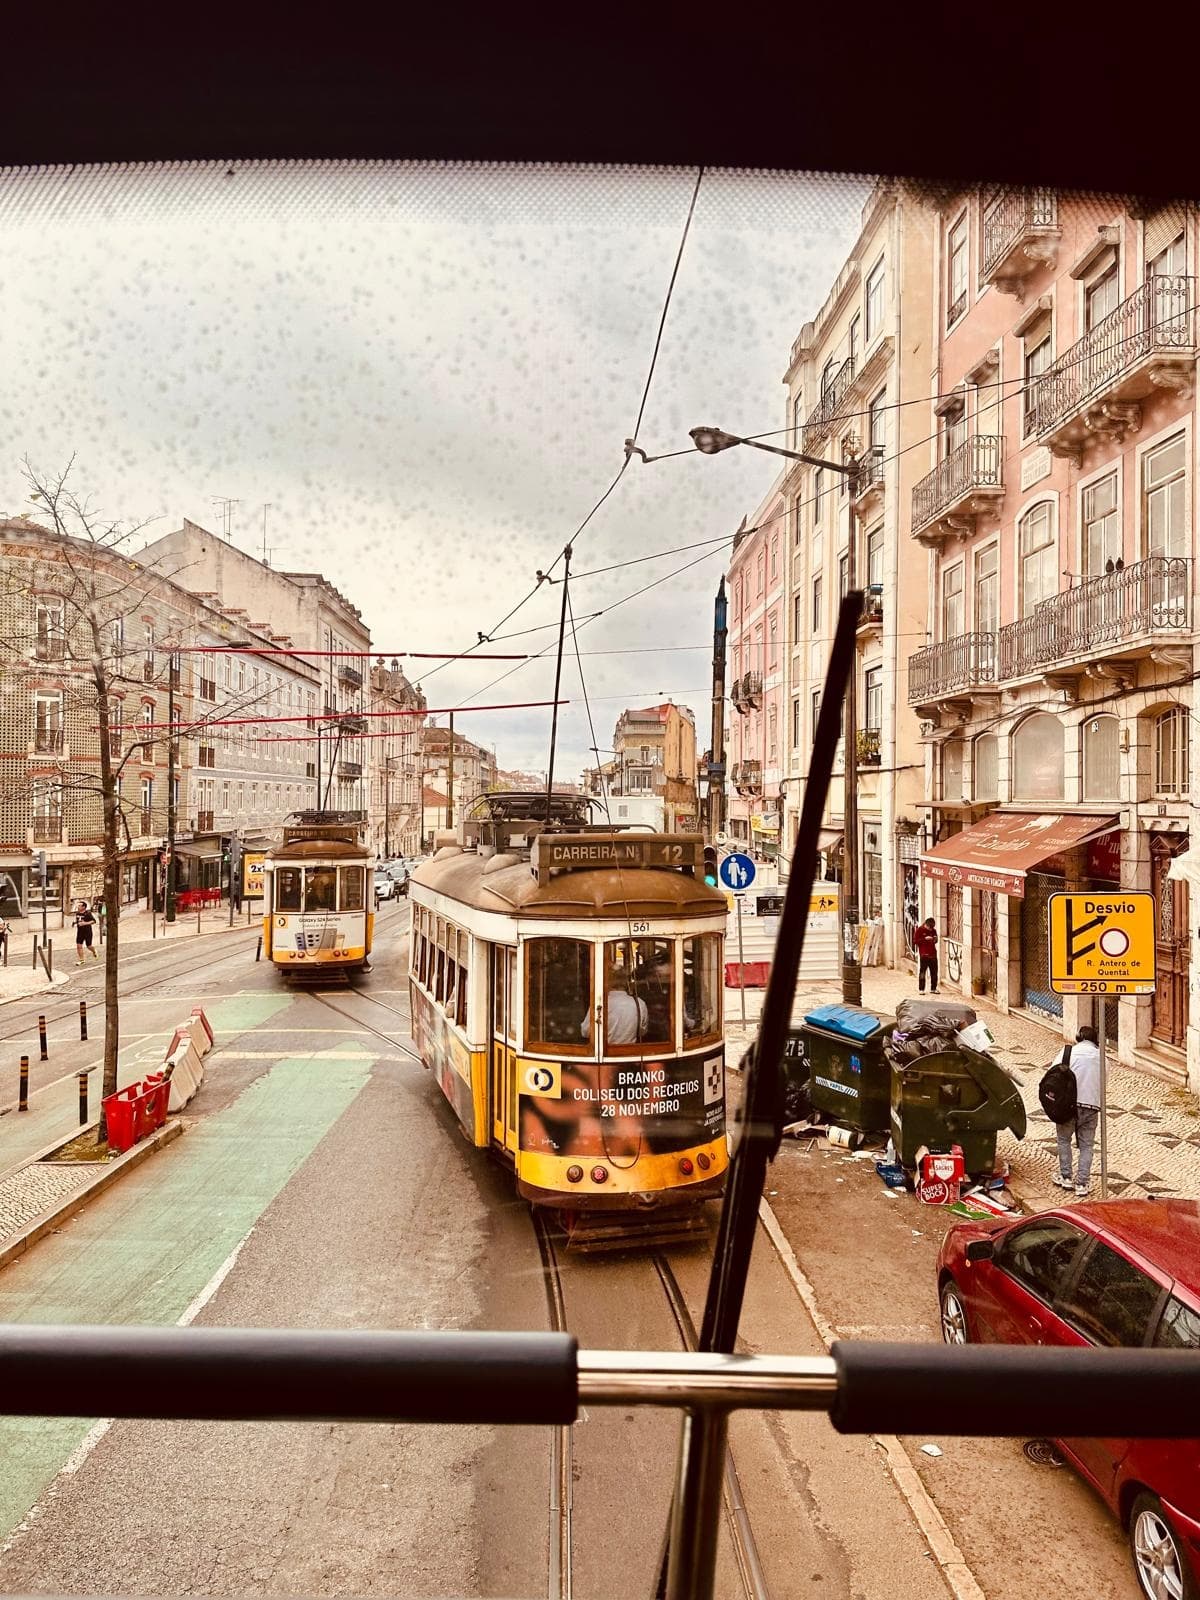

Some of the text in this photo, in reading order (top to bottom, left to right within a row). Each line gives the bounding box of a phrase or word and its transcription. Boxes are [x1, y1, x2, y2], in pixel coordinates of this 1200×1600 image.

[1096, 834, 1111, 846] ZIP
[553, 847, 618, 860] CARREIRA
[661, 845, 683, 861] 12
[1084, 901, 1135, 914] Desvio
[633, 922, 650, 932] 561
[1086, 959, 1141, 967] R. Antero de
[1097, 968, 1130, 976] Quental
[1080, 982, 1107, 992] 250
[1115, 984, 1127, 992] m
[618, 1070, 665, 1085] BRANKO
[573, 1079, 699, 1101] COLISEU DOS RECREIOS
[601, 1099, 680, 1117] 28 NOVEMBRO
[921, 1183, 943, 1195] SUPER
[925, 1189, 945, 1201] BOCK
